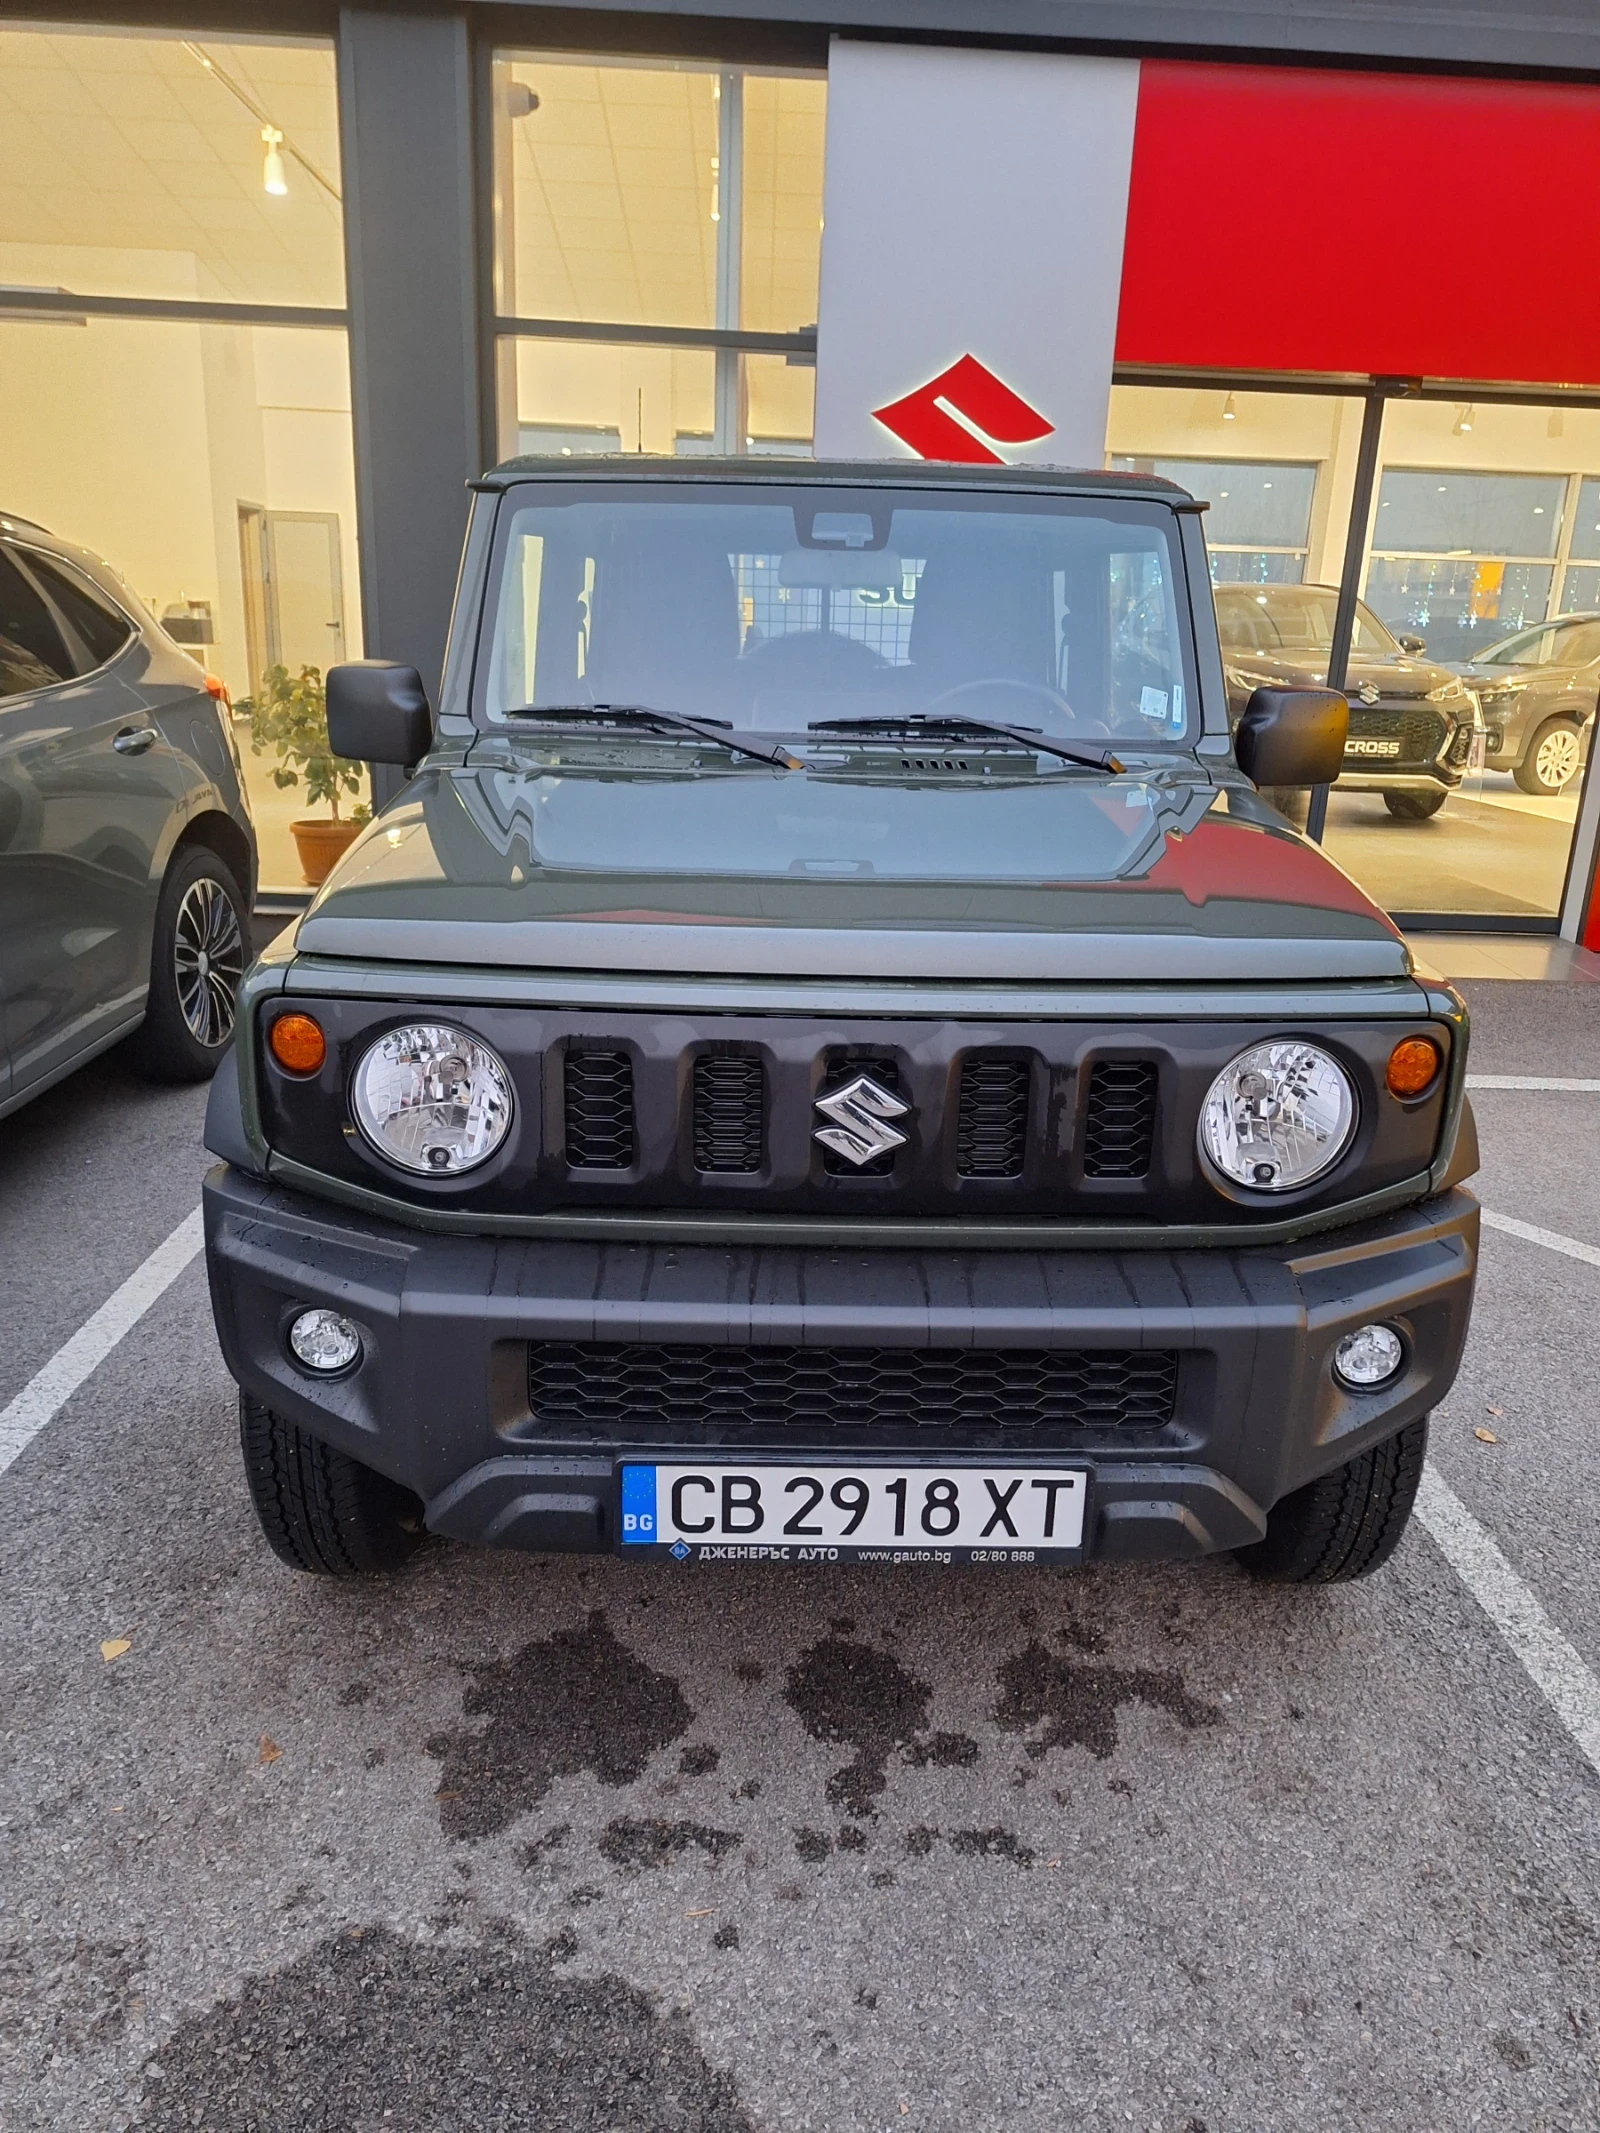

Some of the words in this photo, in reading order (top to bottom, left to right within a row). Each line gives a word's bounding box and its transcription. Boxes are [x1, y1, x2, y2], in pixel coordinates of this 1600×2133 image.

[1344, 740, 1400, 754] CROSS
[671, 1475, 765, 1534] CB
[783, 1477, 960, 1537] 2918
[979, 1478, 1075, 1538] XT
[623, 1513, 653, 1531] BG
[797, 1547, 839, 1561] АУТО
[857, 1549, 952, 1564] www.gauto.bg
[970, 1550, 1007, 1562] 02/80
[1010, 1550, 1035, 1562] 888
